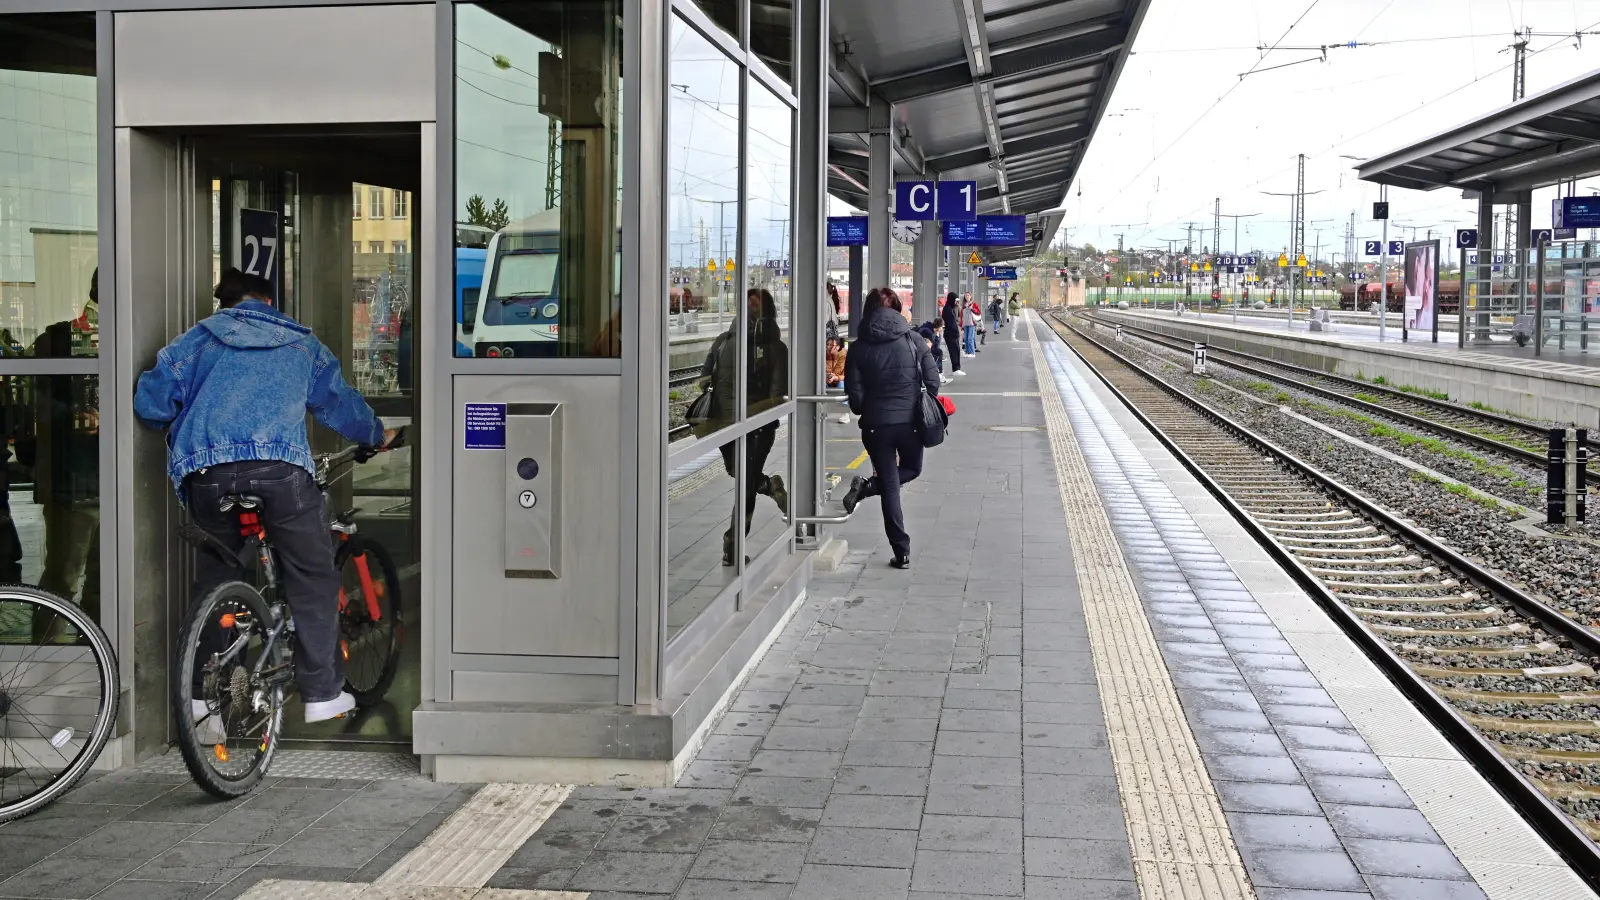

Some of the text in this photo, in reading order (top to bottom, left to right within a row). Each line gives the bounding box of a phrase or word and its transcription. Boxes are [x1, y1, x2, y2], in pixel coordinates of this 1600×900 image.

[909, 184, 971, 212] C 1
[1460, 230, 1470, 245] C
[1367, 242, 1402, 253] 2 3
[244, 234, 277, 280] 27
[1216, 257, 1256, 265] 2 D D 3
[1195, 350, 1205, 365] H
